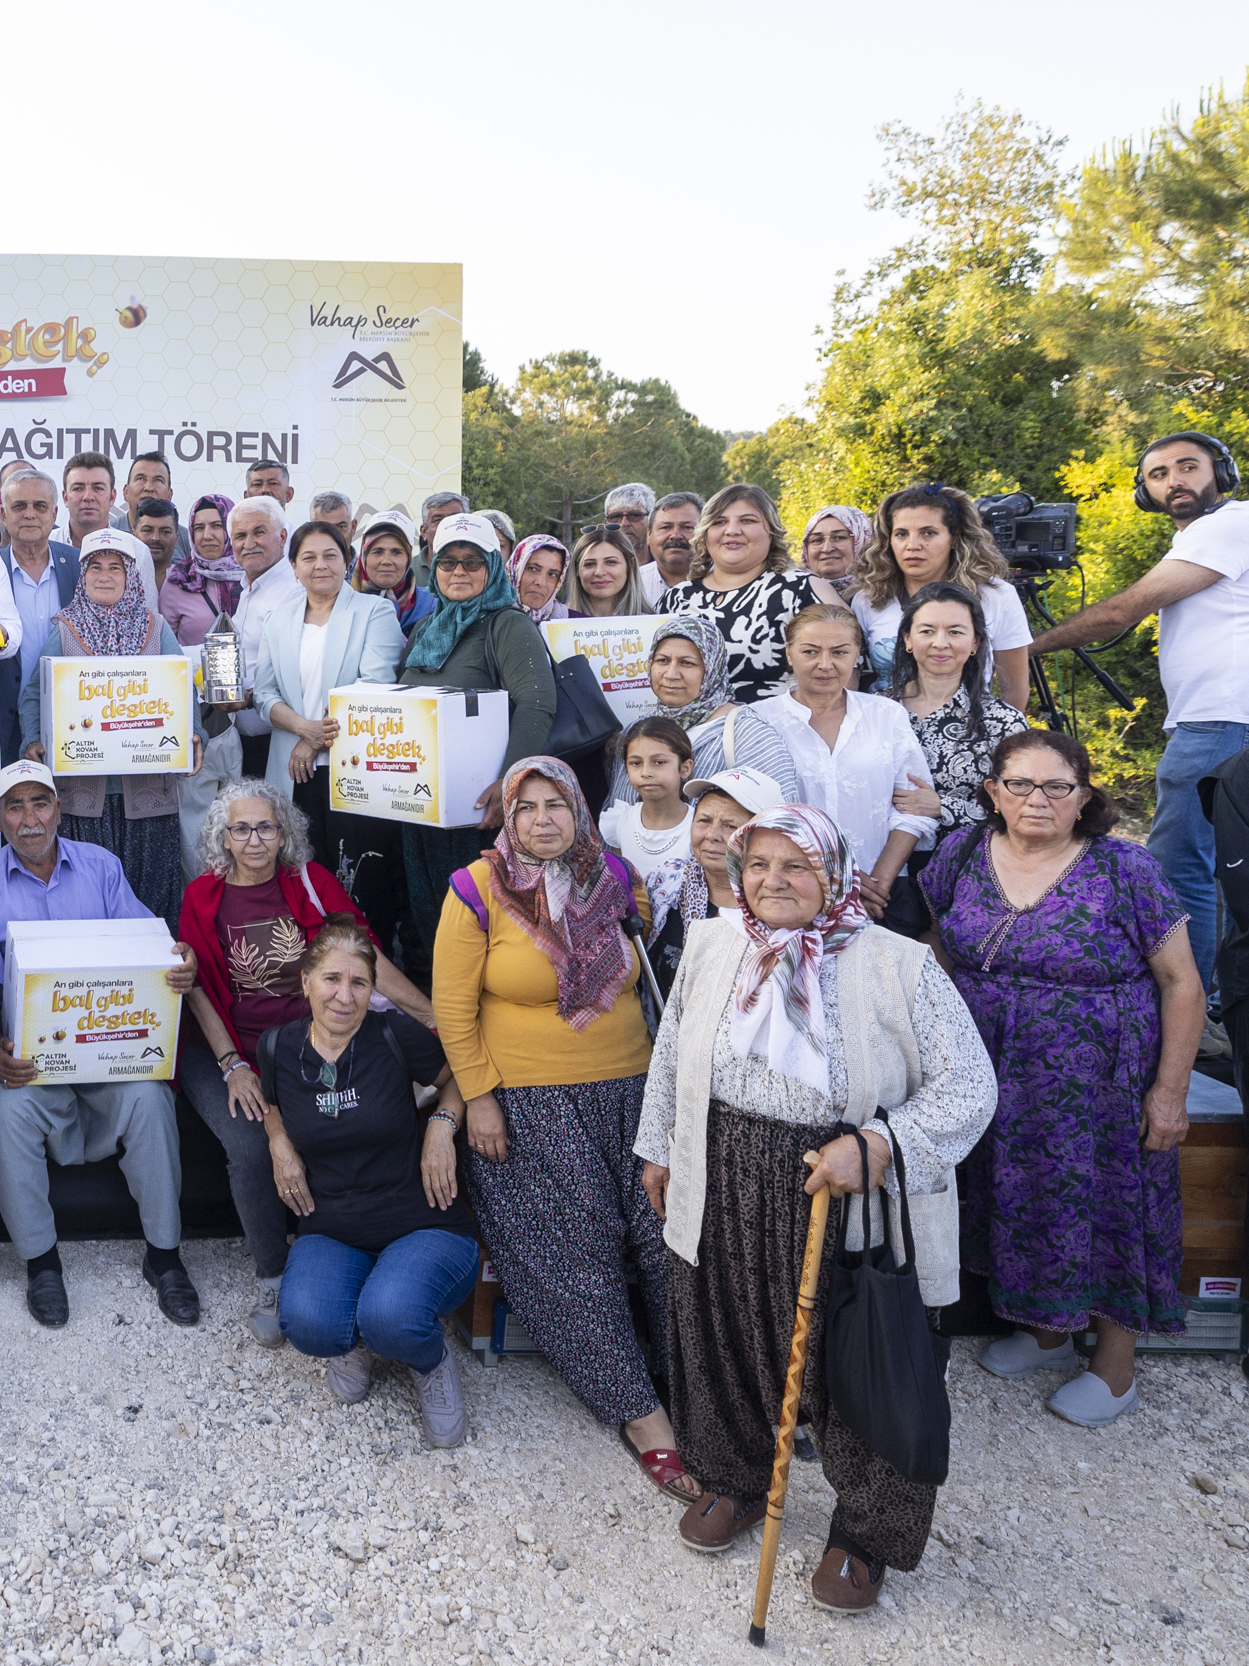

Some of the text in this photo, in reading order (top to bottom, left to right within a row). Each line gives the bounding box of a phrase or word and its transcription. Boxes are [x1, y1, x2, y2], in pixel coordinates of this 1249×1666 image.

[310, 301, 368, 340] Vahap
[149, 421, 299, 465] TÖRENİ
[612, 636, 643, 661] gibi
[91, 670, 105, 679] gibi
[106, 670, 147, 679] çalışanlara
[600, 658, 648, 680] dest
[78, 678, 148, 702] bal gibi
[357, 704, 369, 713] gibi
[369, 704, 402, 715] çalışanlara
[348, 713, 404, 740] bal gibi
[76, 751, 104, 759] PROJESİ
[346, 778, 362, 786] ALTIN
[346, 791, 369, 800] PROJESİ
[68, 980, 84, 989] gibi
[86, 979, 133, 989] çalışanlara
[52, 988, 134, 1013] bal gibi
[44, 1064, 77, 1072] PROJESİ
